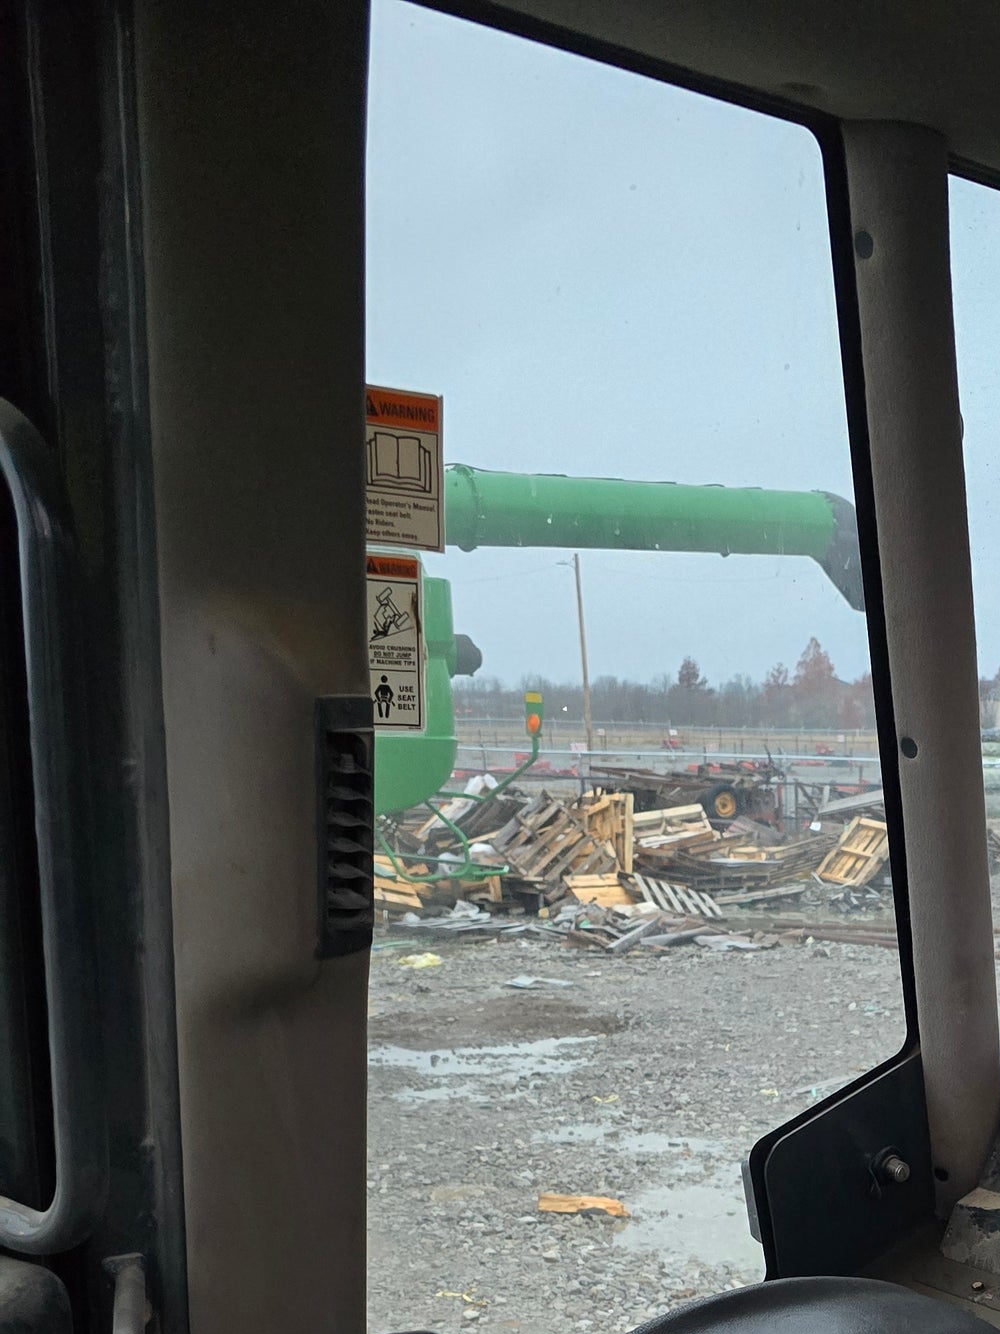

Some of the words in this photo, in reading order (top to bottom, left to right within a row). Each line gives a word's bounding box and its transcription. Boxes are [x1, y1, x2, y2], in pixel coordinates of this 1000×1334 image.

[379, 400, 435, 422] WARNING
[380, 498, 411, 510] Operator's
[381, 530, 400, 538] others
[386, 645, 416, 653] CRUSHING
[397, 703, 416, 711] BELT
